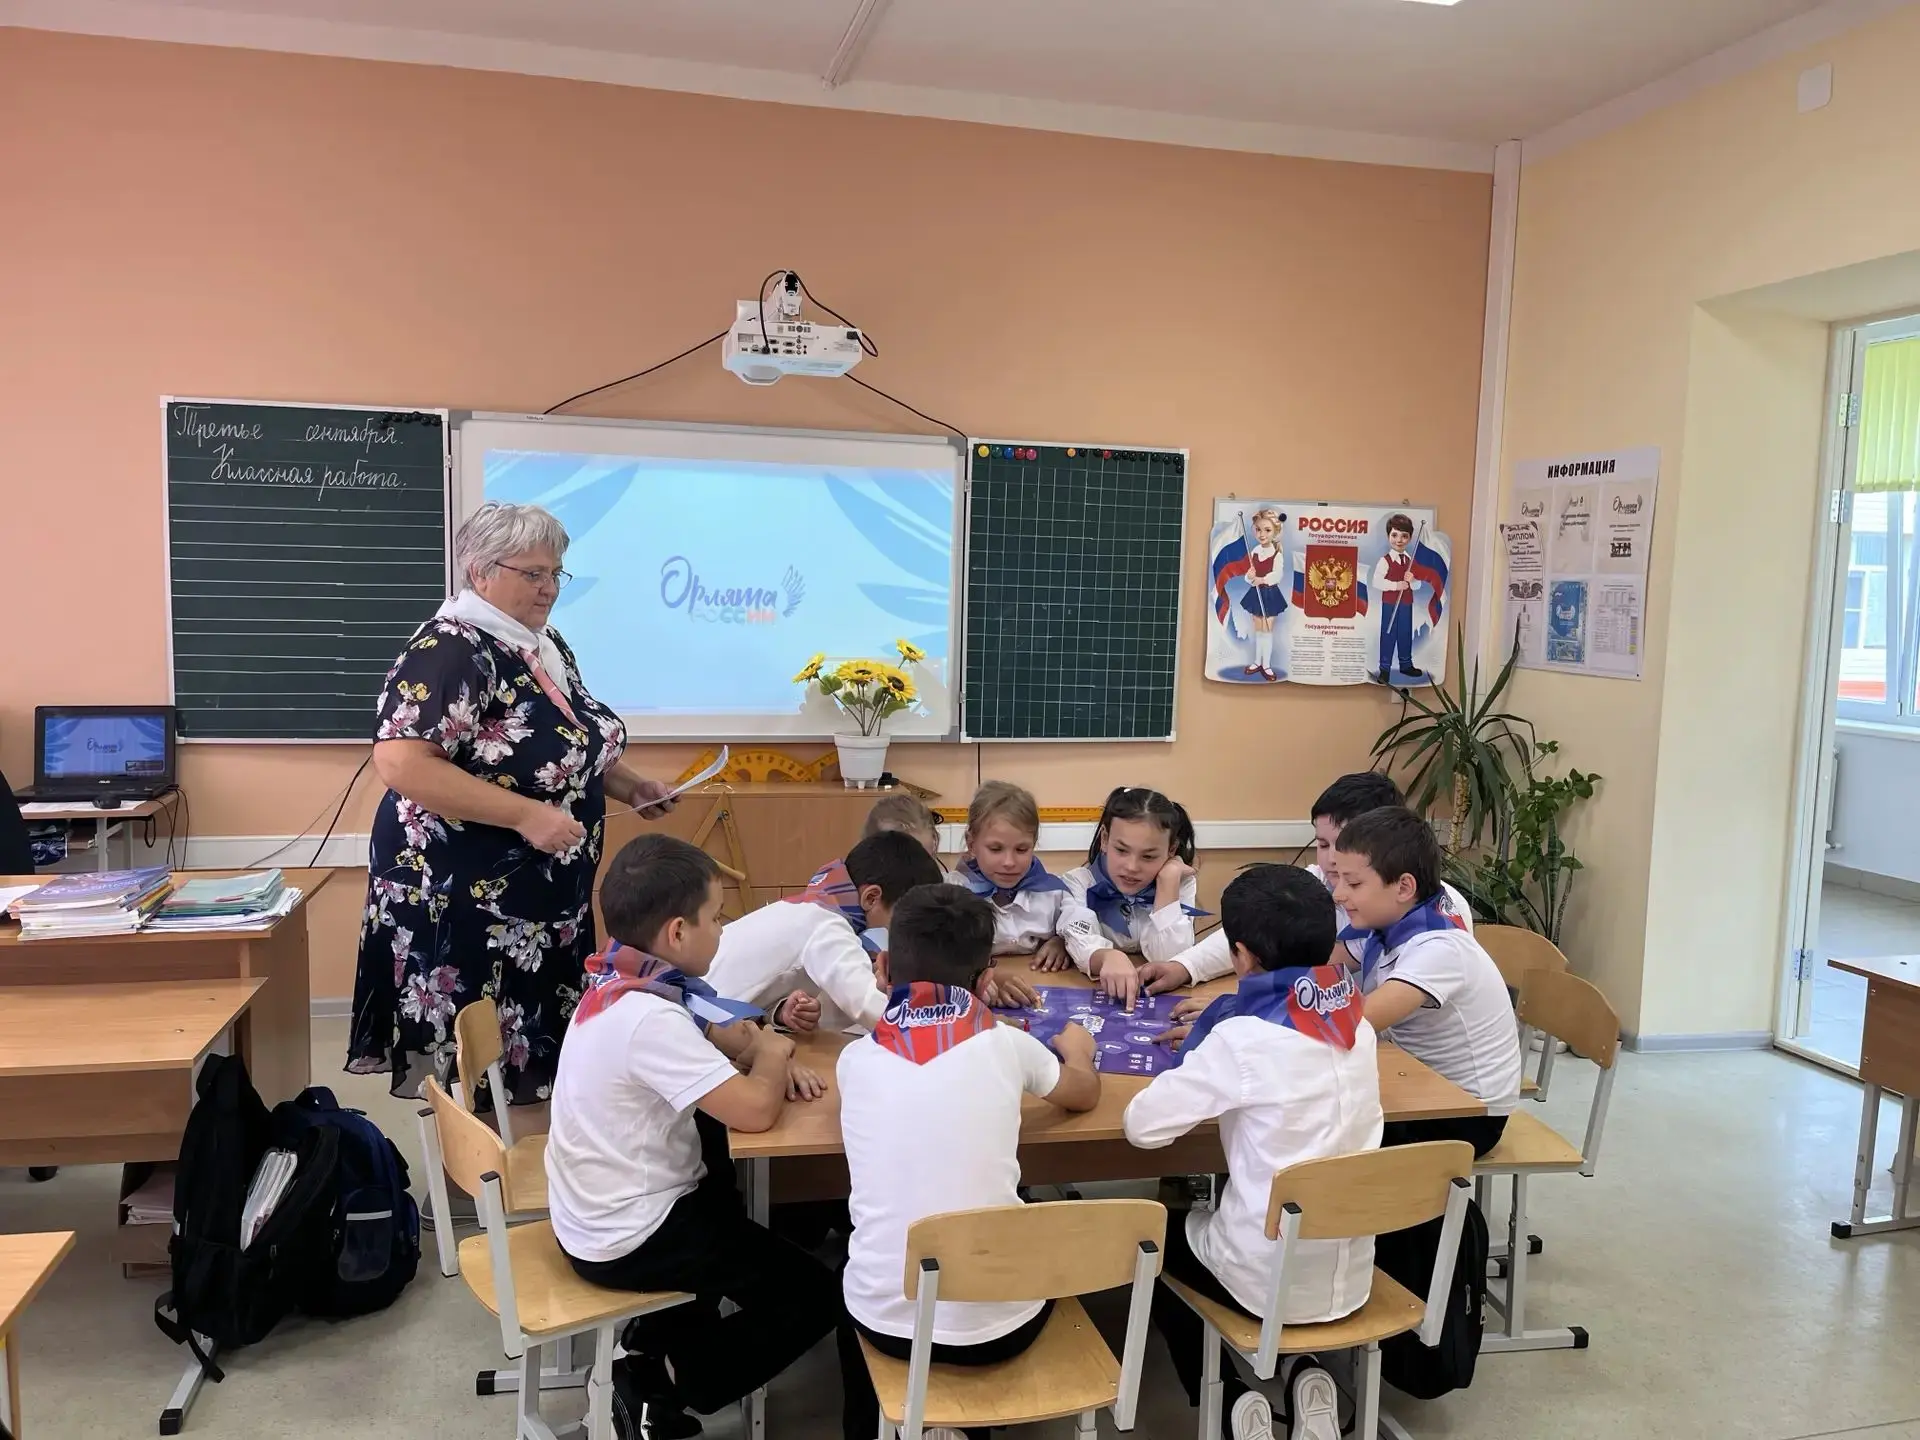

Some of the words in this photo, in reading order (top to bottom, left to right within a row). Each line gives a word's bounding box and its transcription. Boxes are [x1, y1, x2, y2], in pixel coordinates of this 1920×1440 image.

[174, 405, 264, 448] Третье
[210, 443, 314, 485] Классная
[317, 459, 407, 502] работа.
[1547, 459, 1616, 479] ИНФОРМАЦИЯ
[1298, 517, 1369, 534] РОССИЯ
[1507, 532, 1535, 542] ДИПЛОМ
[660, 555, 778, 614] Орлята
[1133, 1034, 1151, 1042] 6
